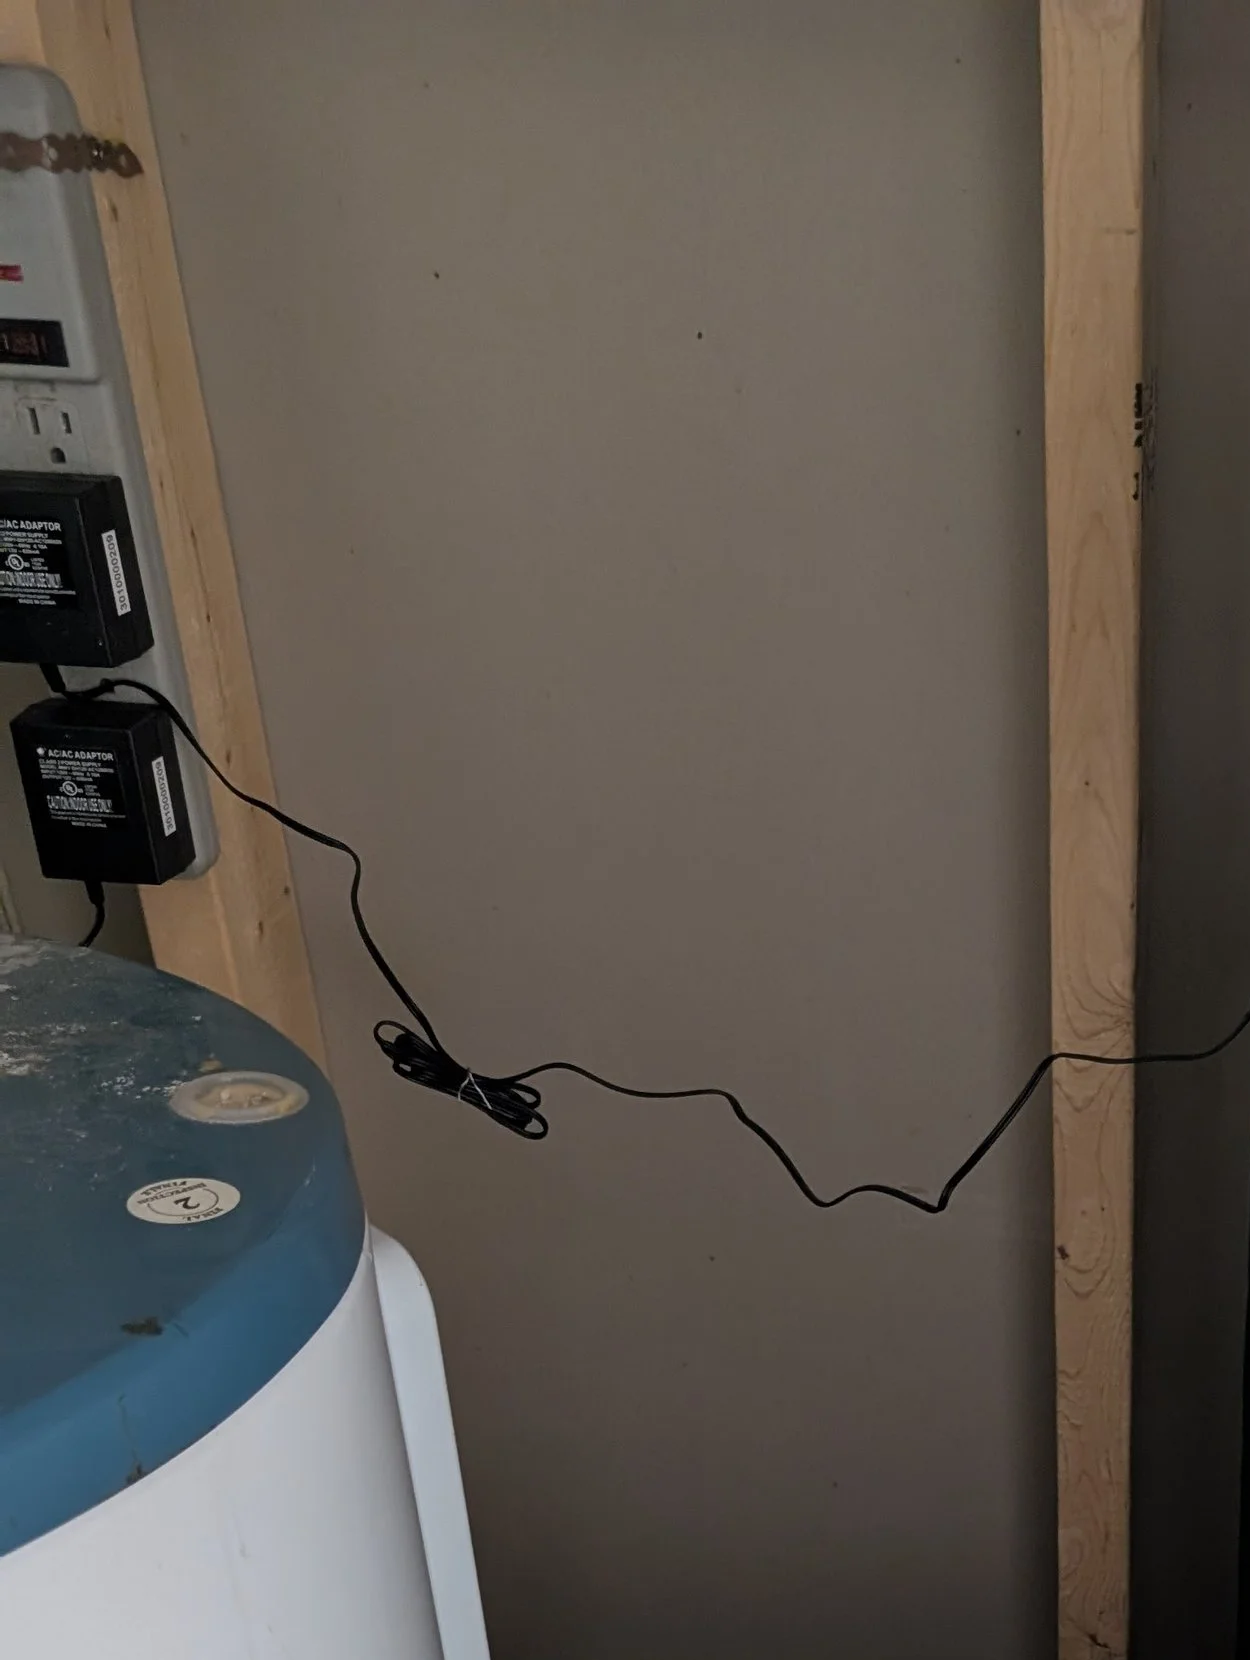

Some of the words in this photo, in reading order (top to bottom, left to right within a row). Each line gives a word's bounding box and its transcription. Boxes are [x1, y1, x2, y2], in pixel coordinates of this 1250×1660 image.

[20, 520, 62, 532] ADAPTOR
[106, 534, 127, 611] 3010000209
[48, 749, 73, 759] AC/AC
[74, 751, 114, 761] ADAPTOR
[136, 1182, 207, 1205] INSPECTION
[173, 1196, 200, 1210] 2
